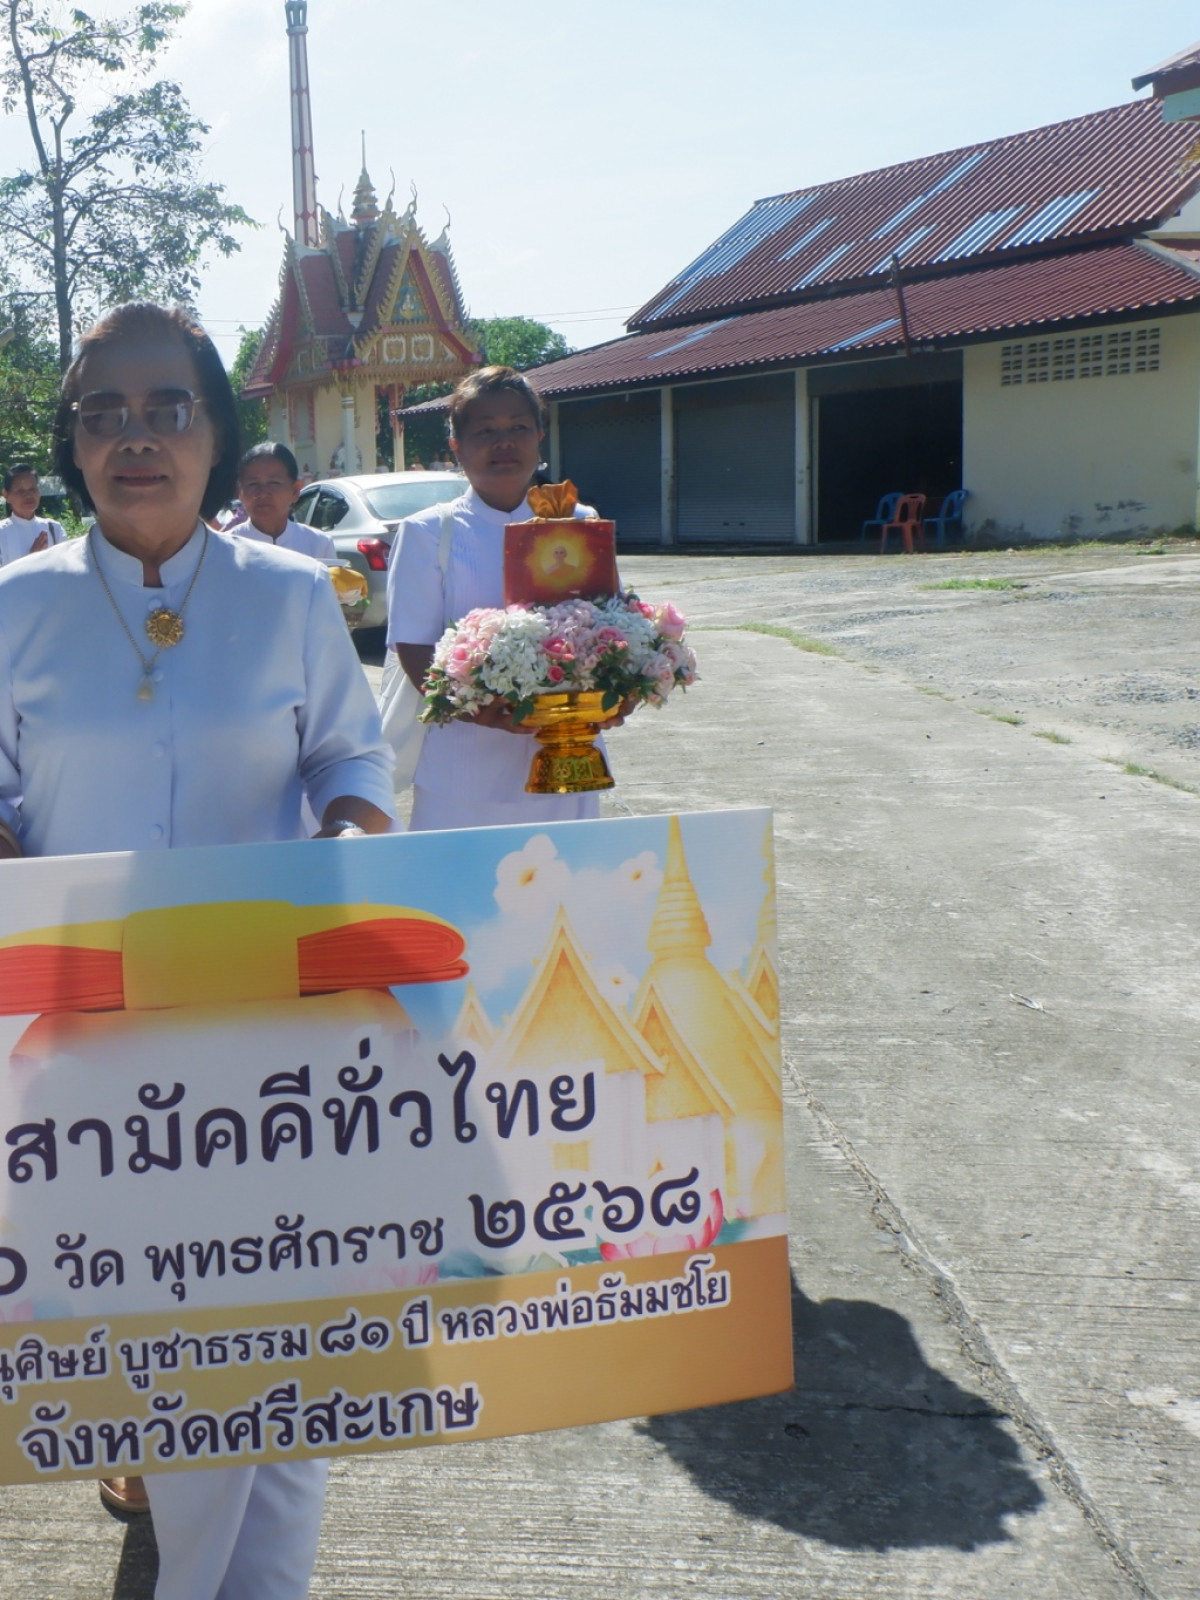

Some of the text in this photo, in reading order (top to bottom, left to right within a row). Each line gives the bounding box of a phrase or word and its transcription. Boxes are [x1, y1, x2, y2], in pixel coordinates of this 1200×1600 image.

[54, 1233, 126, 1291] วัด
[144, 1214, 445, 1302] พุทธศักราช
[468, 1167, 703, 1248] ๒๕๖๘
[120, 1327, 307, 1389] บูชาธรรม
[319, 1313, 389, 1354] ๘๑
[402, 1299, 429, 1346] ปี
[441, 1260, 728, 1341] หลวงพ่อธัมมชโย
[21, 1386, 480, 1469] จังหวัดศรีสะเกษ
